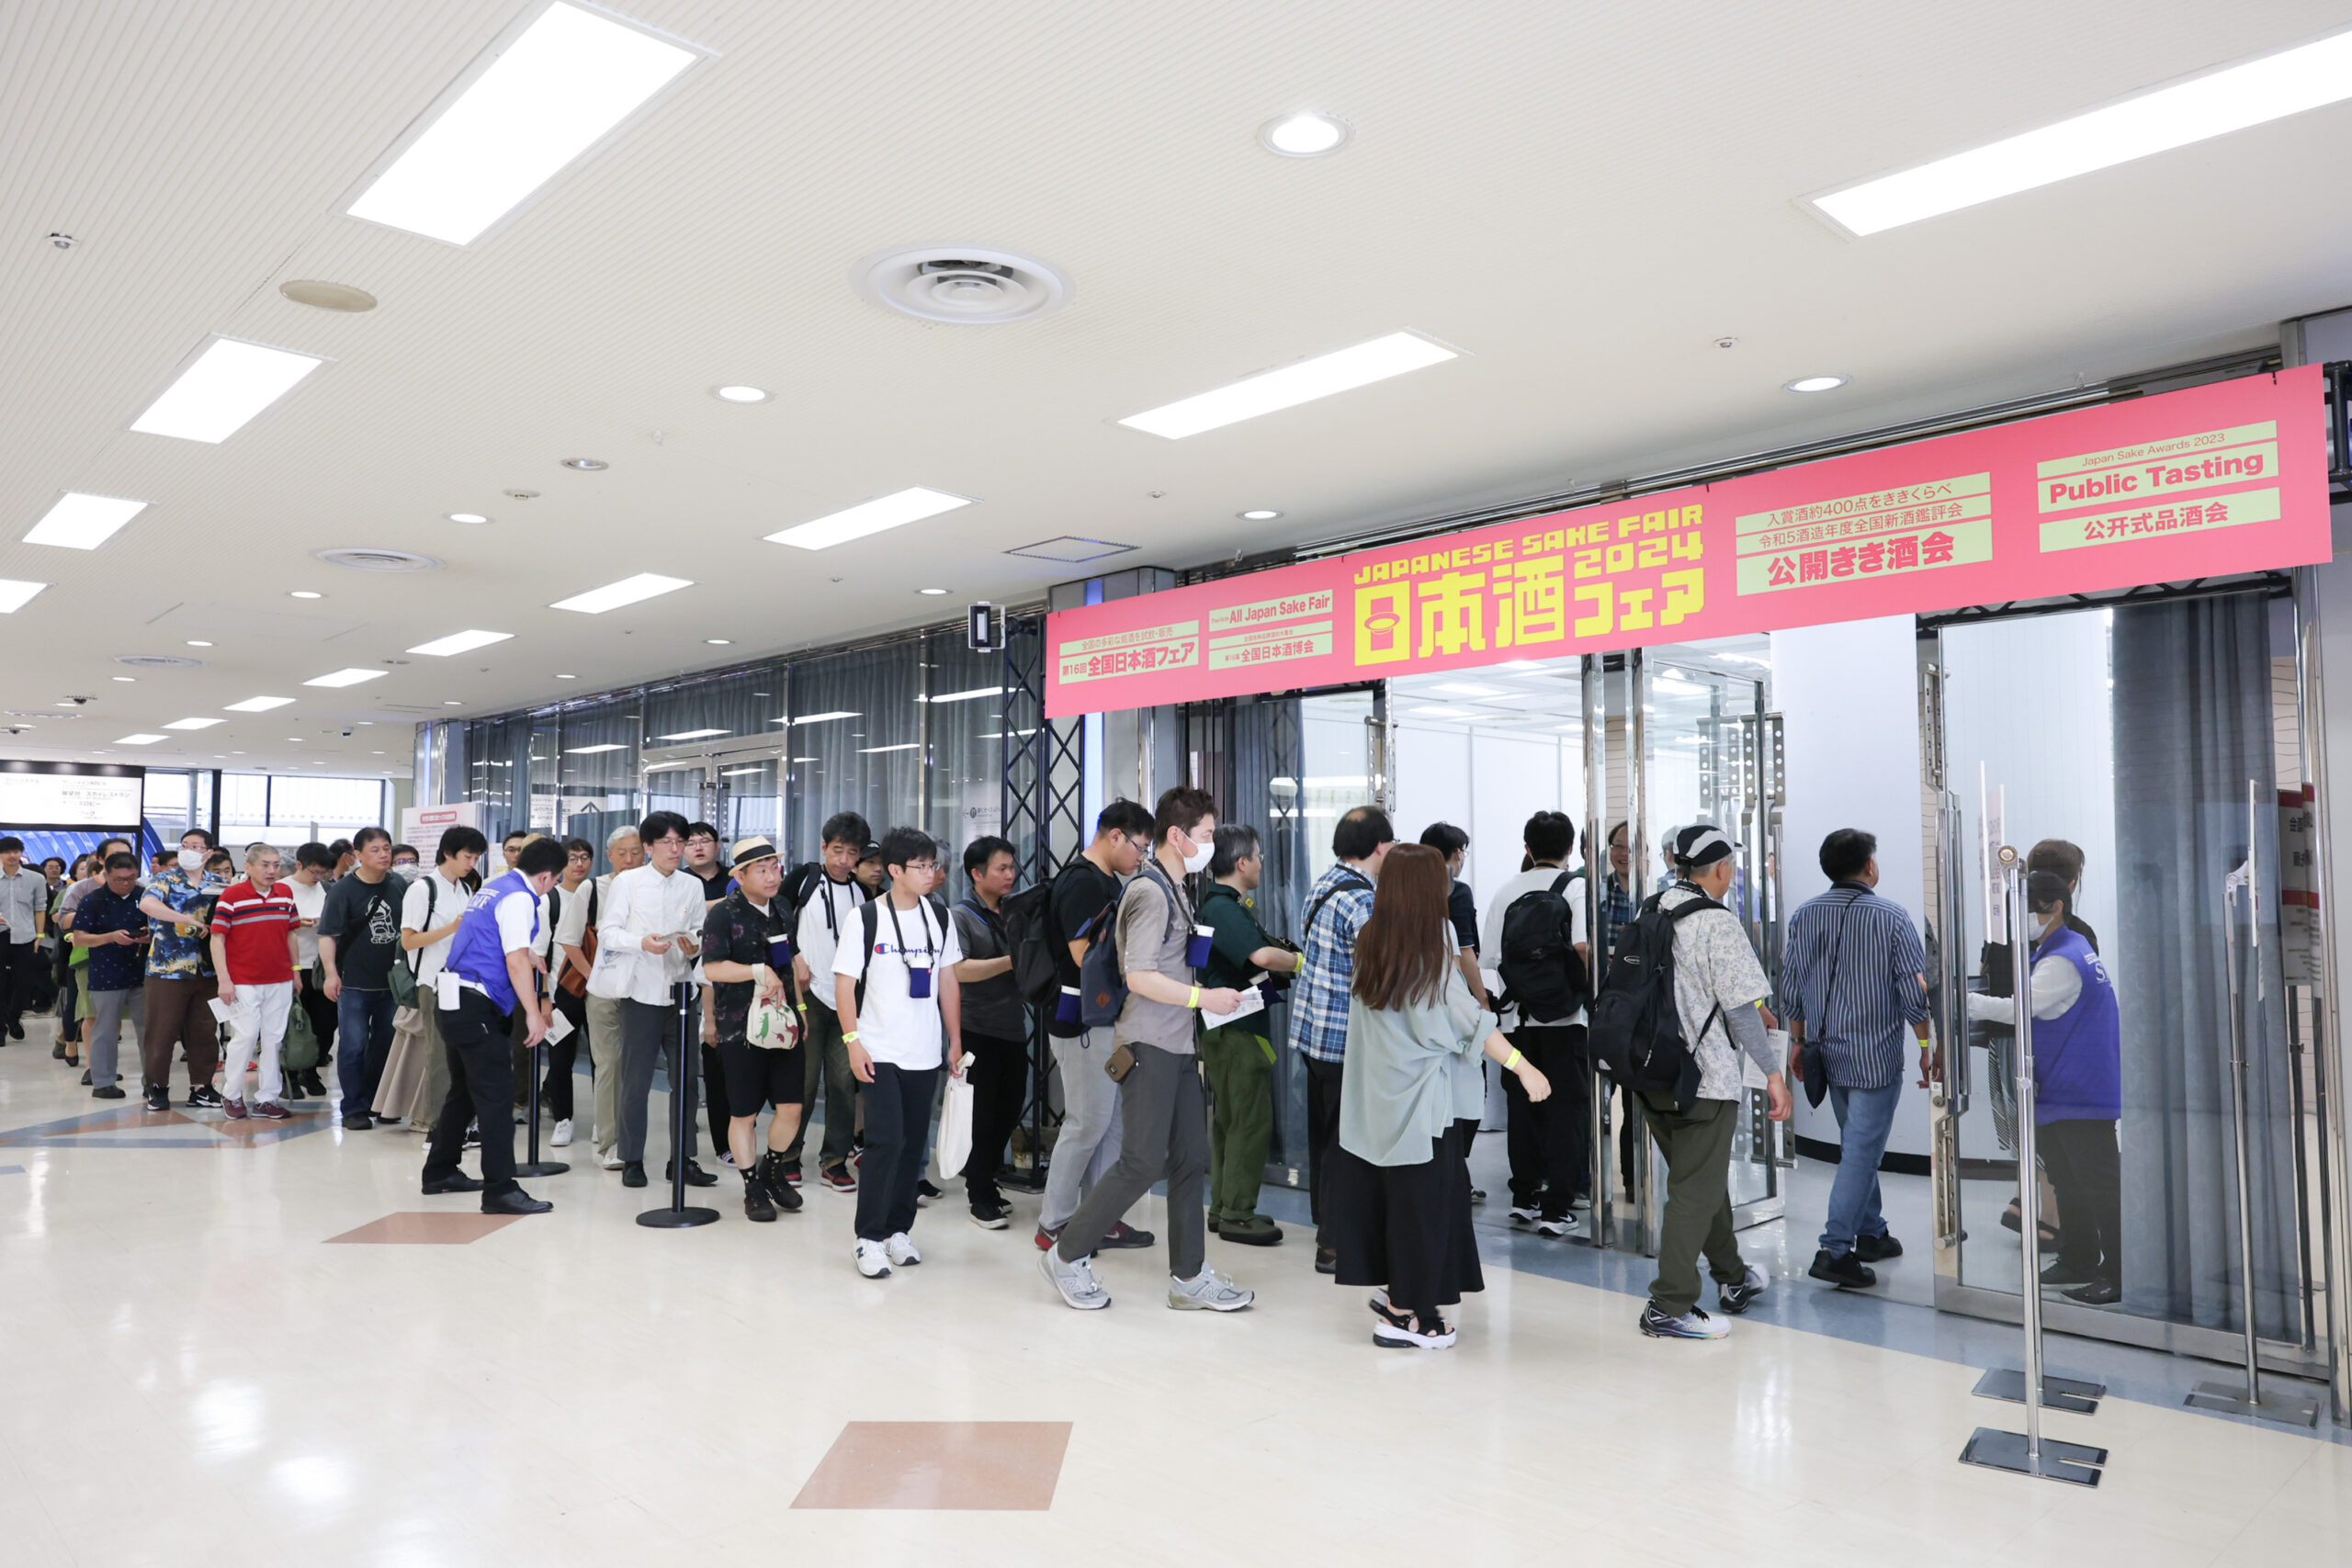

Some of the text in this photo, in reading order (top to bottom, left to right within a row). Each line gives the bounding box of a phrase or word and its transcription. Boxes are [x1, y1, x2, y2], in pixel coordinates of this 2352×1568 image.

[2082, 433, 2225, 468] Japan Sake Awards 2023
[2050, 454, 2264, 504] Public Tasting
[1758, 502, 1963, 549] 令和5酒造年度全国新酒鑑評会
[1767, 482, 1952, 527] 入賞酒約400点をききくらべ
[2084, 502, 2229, 541] 公开式品酒会
[1353, 504, 1703, 586] JAPANESE SAKE FAIR
[1573, 530, 1703, 581] 2024
[1767, 530, 1955, 587] 公開きき酒会
[1229, 608, 1243, 625] All
[1245, 605, 1277, 622] Japan
[1279, 599, 1306, 615] Sake
[1308, 594, 1330, 611] Fair
[1353, 554, 1705, 668] 日本酒フェア
[1088, 641, 1196, 677] 全国日本酒フェア
[1241, 638, 1315, 662] 全国日本酒博会
[875, 942, 940, 958] Chmpin
